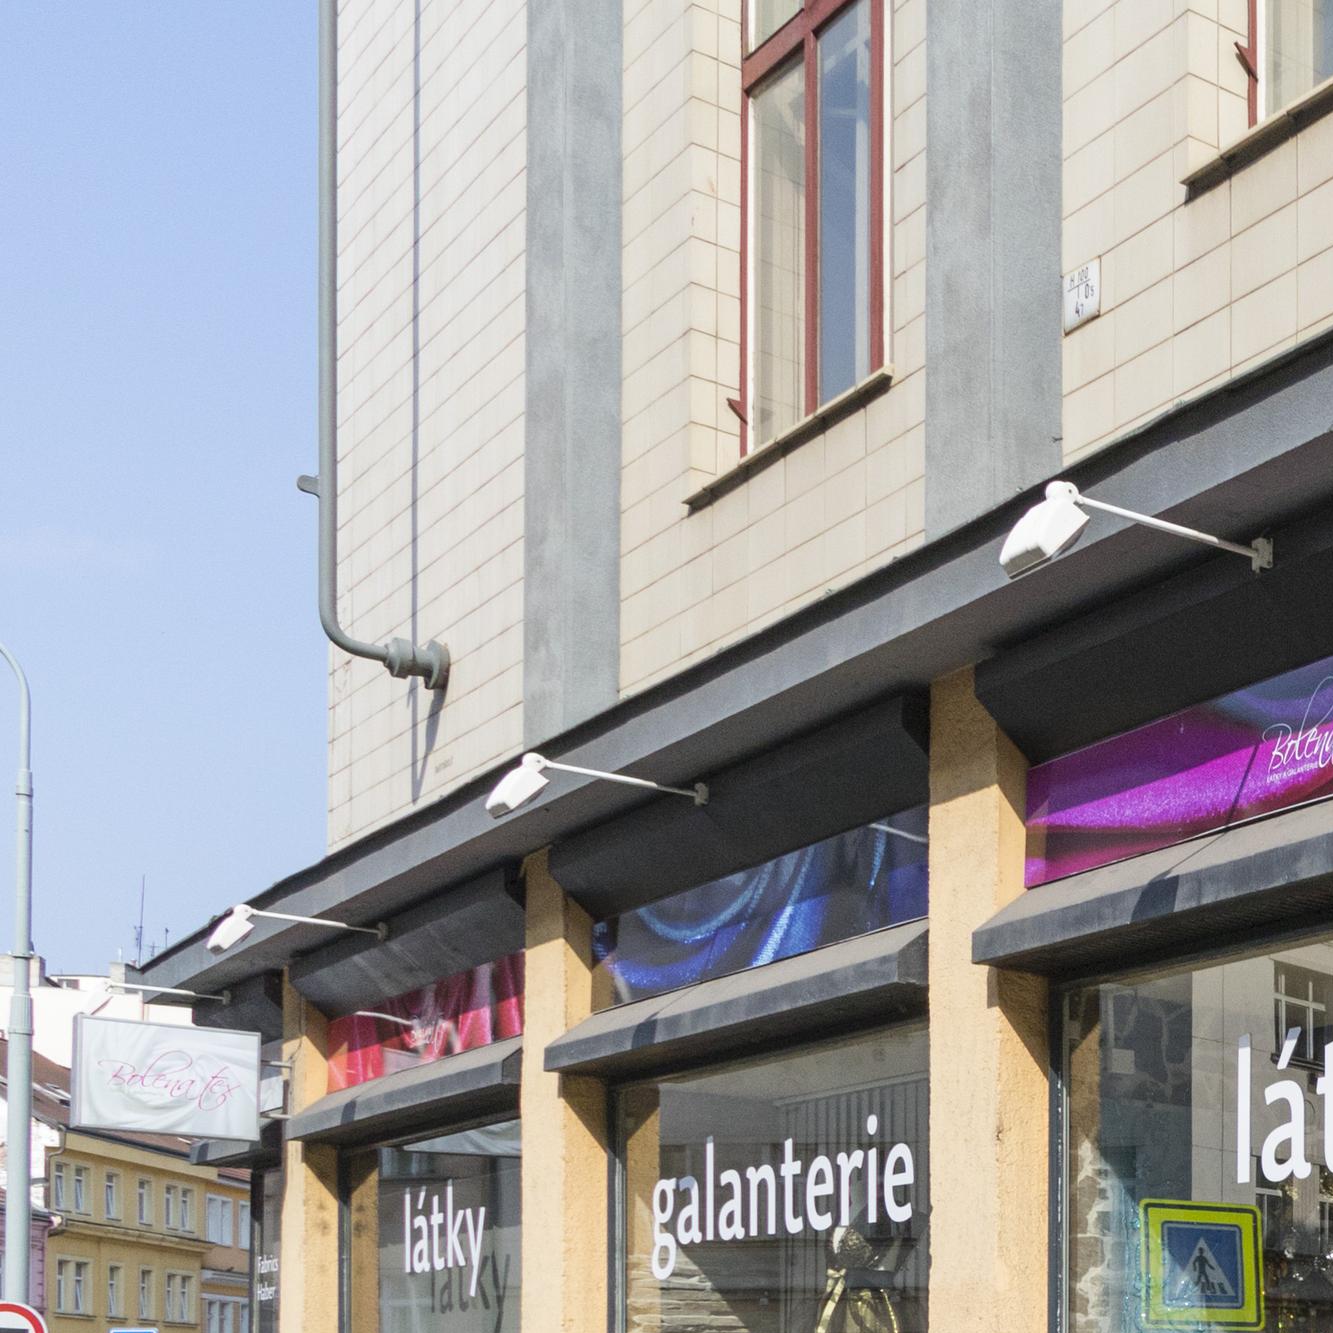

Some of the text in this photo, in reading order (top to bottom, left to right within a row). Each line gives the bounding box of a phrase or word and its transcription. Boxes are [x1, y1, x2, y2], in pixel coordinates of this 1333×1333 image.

[98, 1050, 241, 1112] Bolena tex
[404, 1178, 486, 1297] látky
[651, 1113, 915, 1281] galanterie
[256, 1254, 279, 1274] Fabrics
